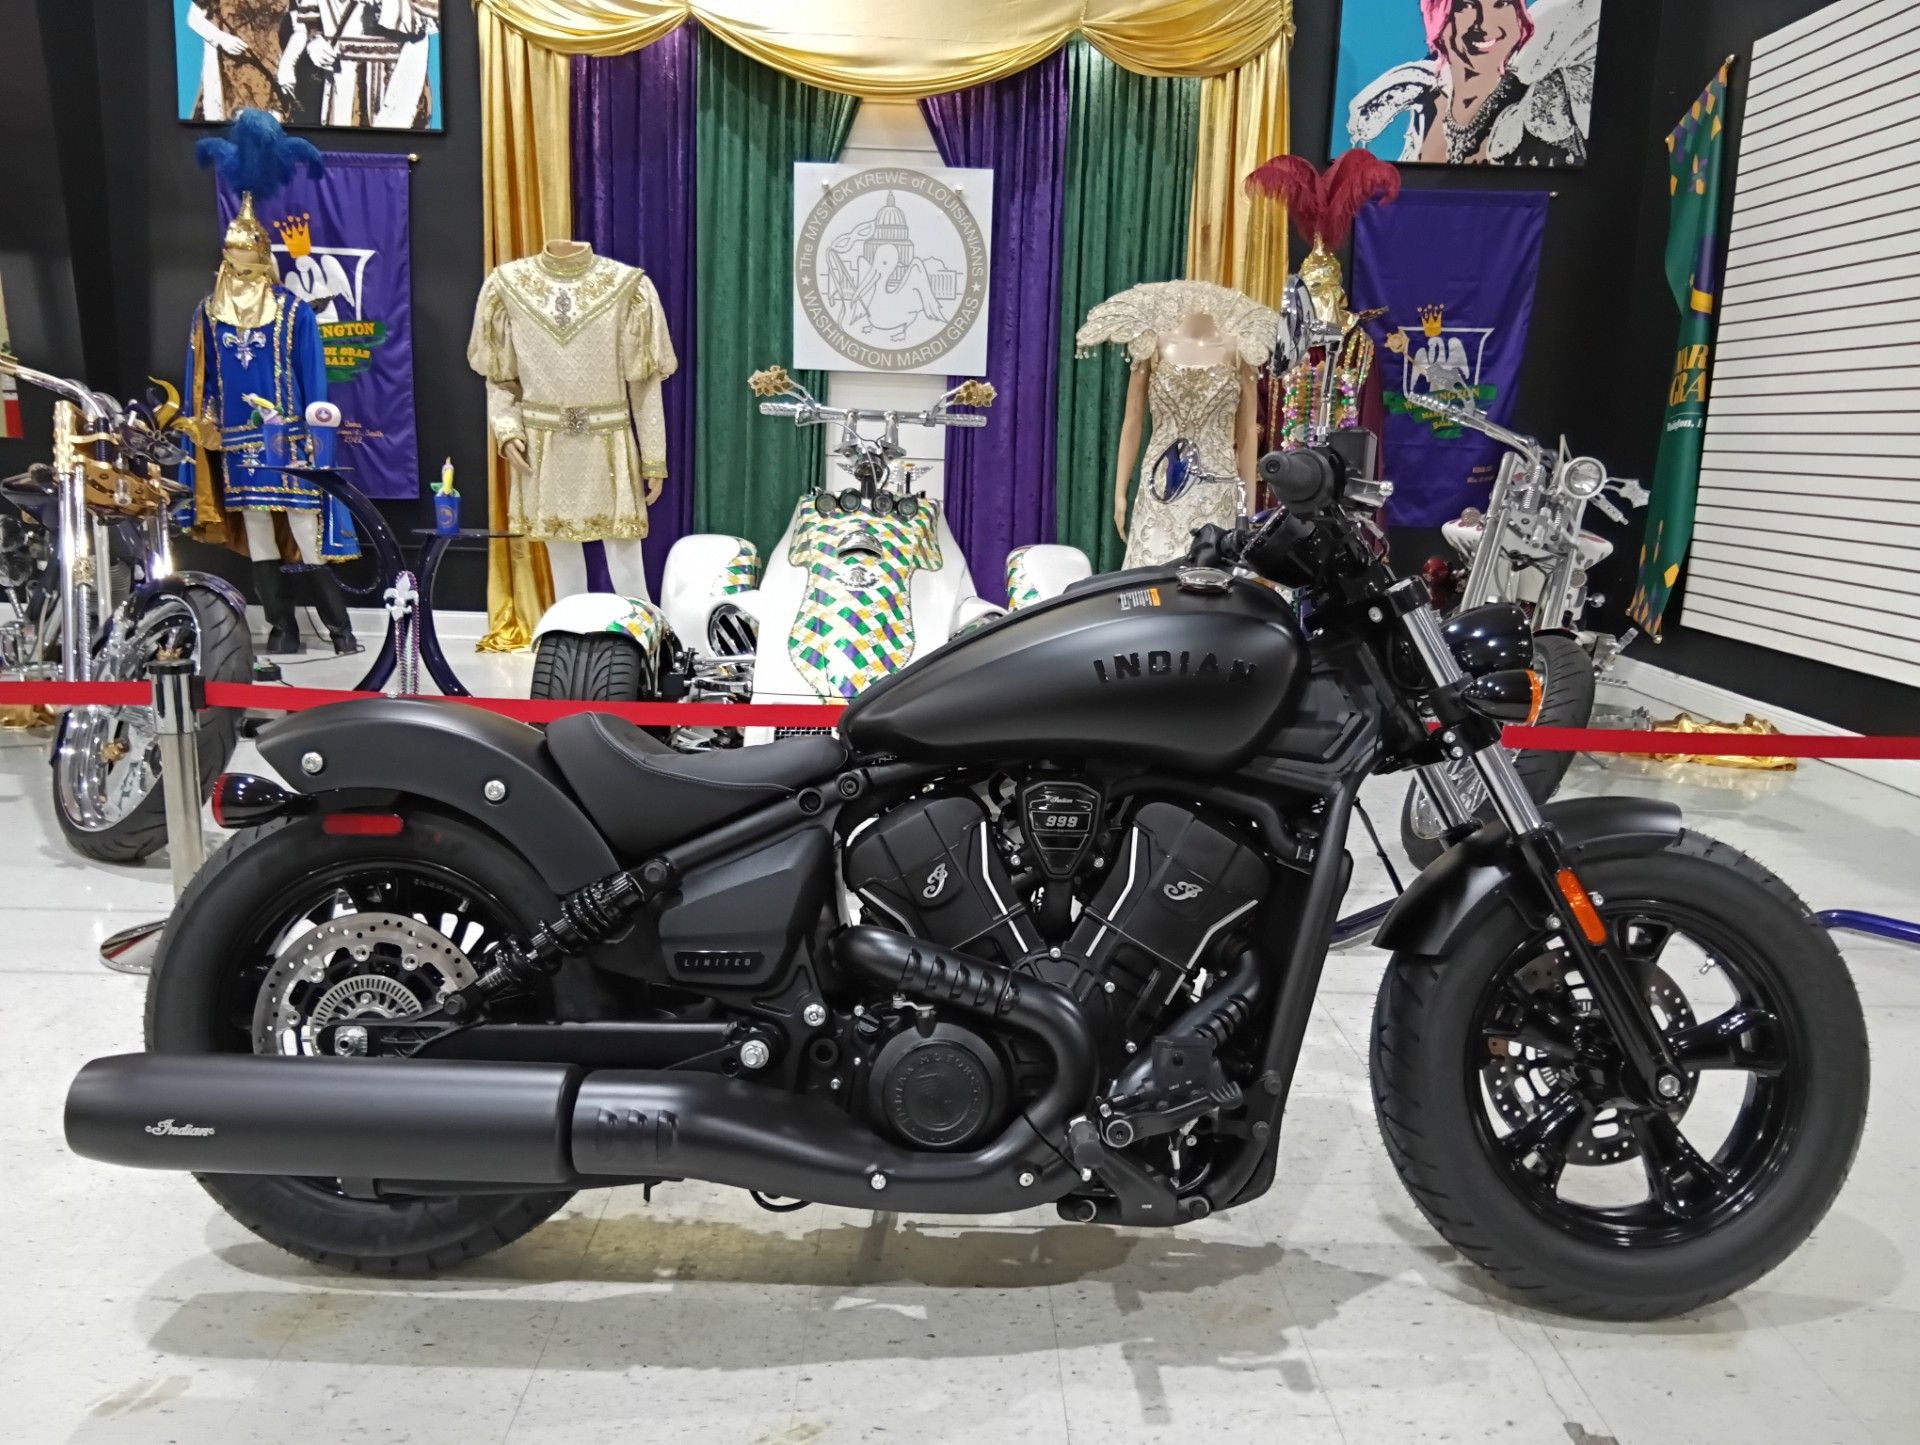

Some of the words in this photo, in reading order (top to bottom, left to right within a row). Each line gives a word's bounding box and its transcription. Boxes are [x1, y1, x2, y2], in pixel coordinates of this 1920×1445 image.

[854, 172, 908, 190] KREWE
[911, 177, 926, 189] of
[805, 183, 854, 240] MYSTICK
[927, 184, 984, 277] LOUISIANIANS
[800, 243, 814, 270] The
[321, 322, 375, 338] NGTON
[802, 290, 893, 367] WASHINGTON
[897, 337, 949, 367] MARDI
[946, 297, 980, 341] GRAS
[1093, 650, 1258, 684] INDIAN
[1045, 815, 1079, 828] 999
[684, 958, 751, 967] LIMITED
[144, 1118, 216, 1137] Indian
